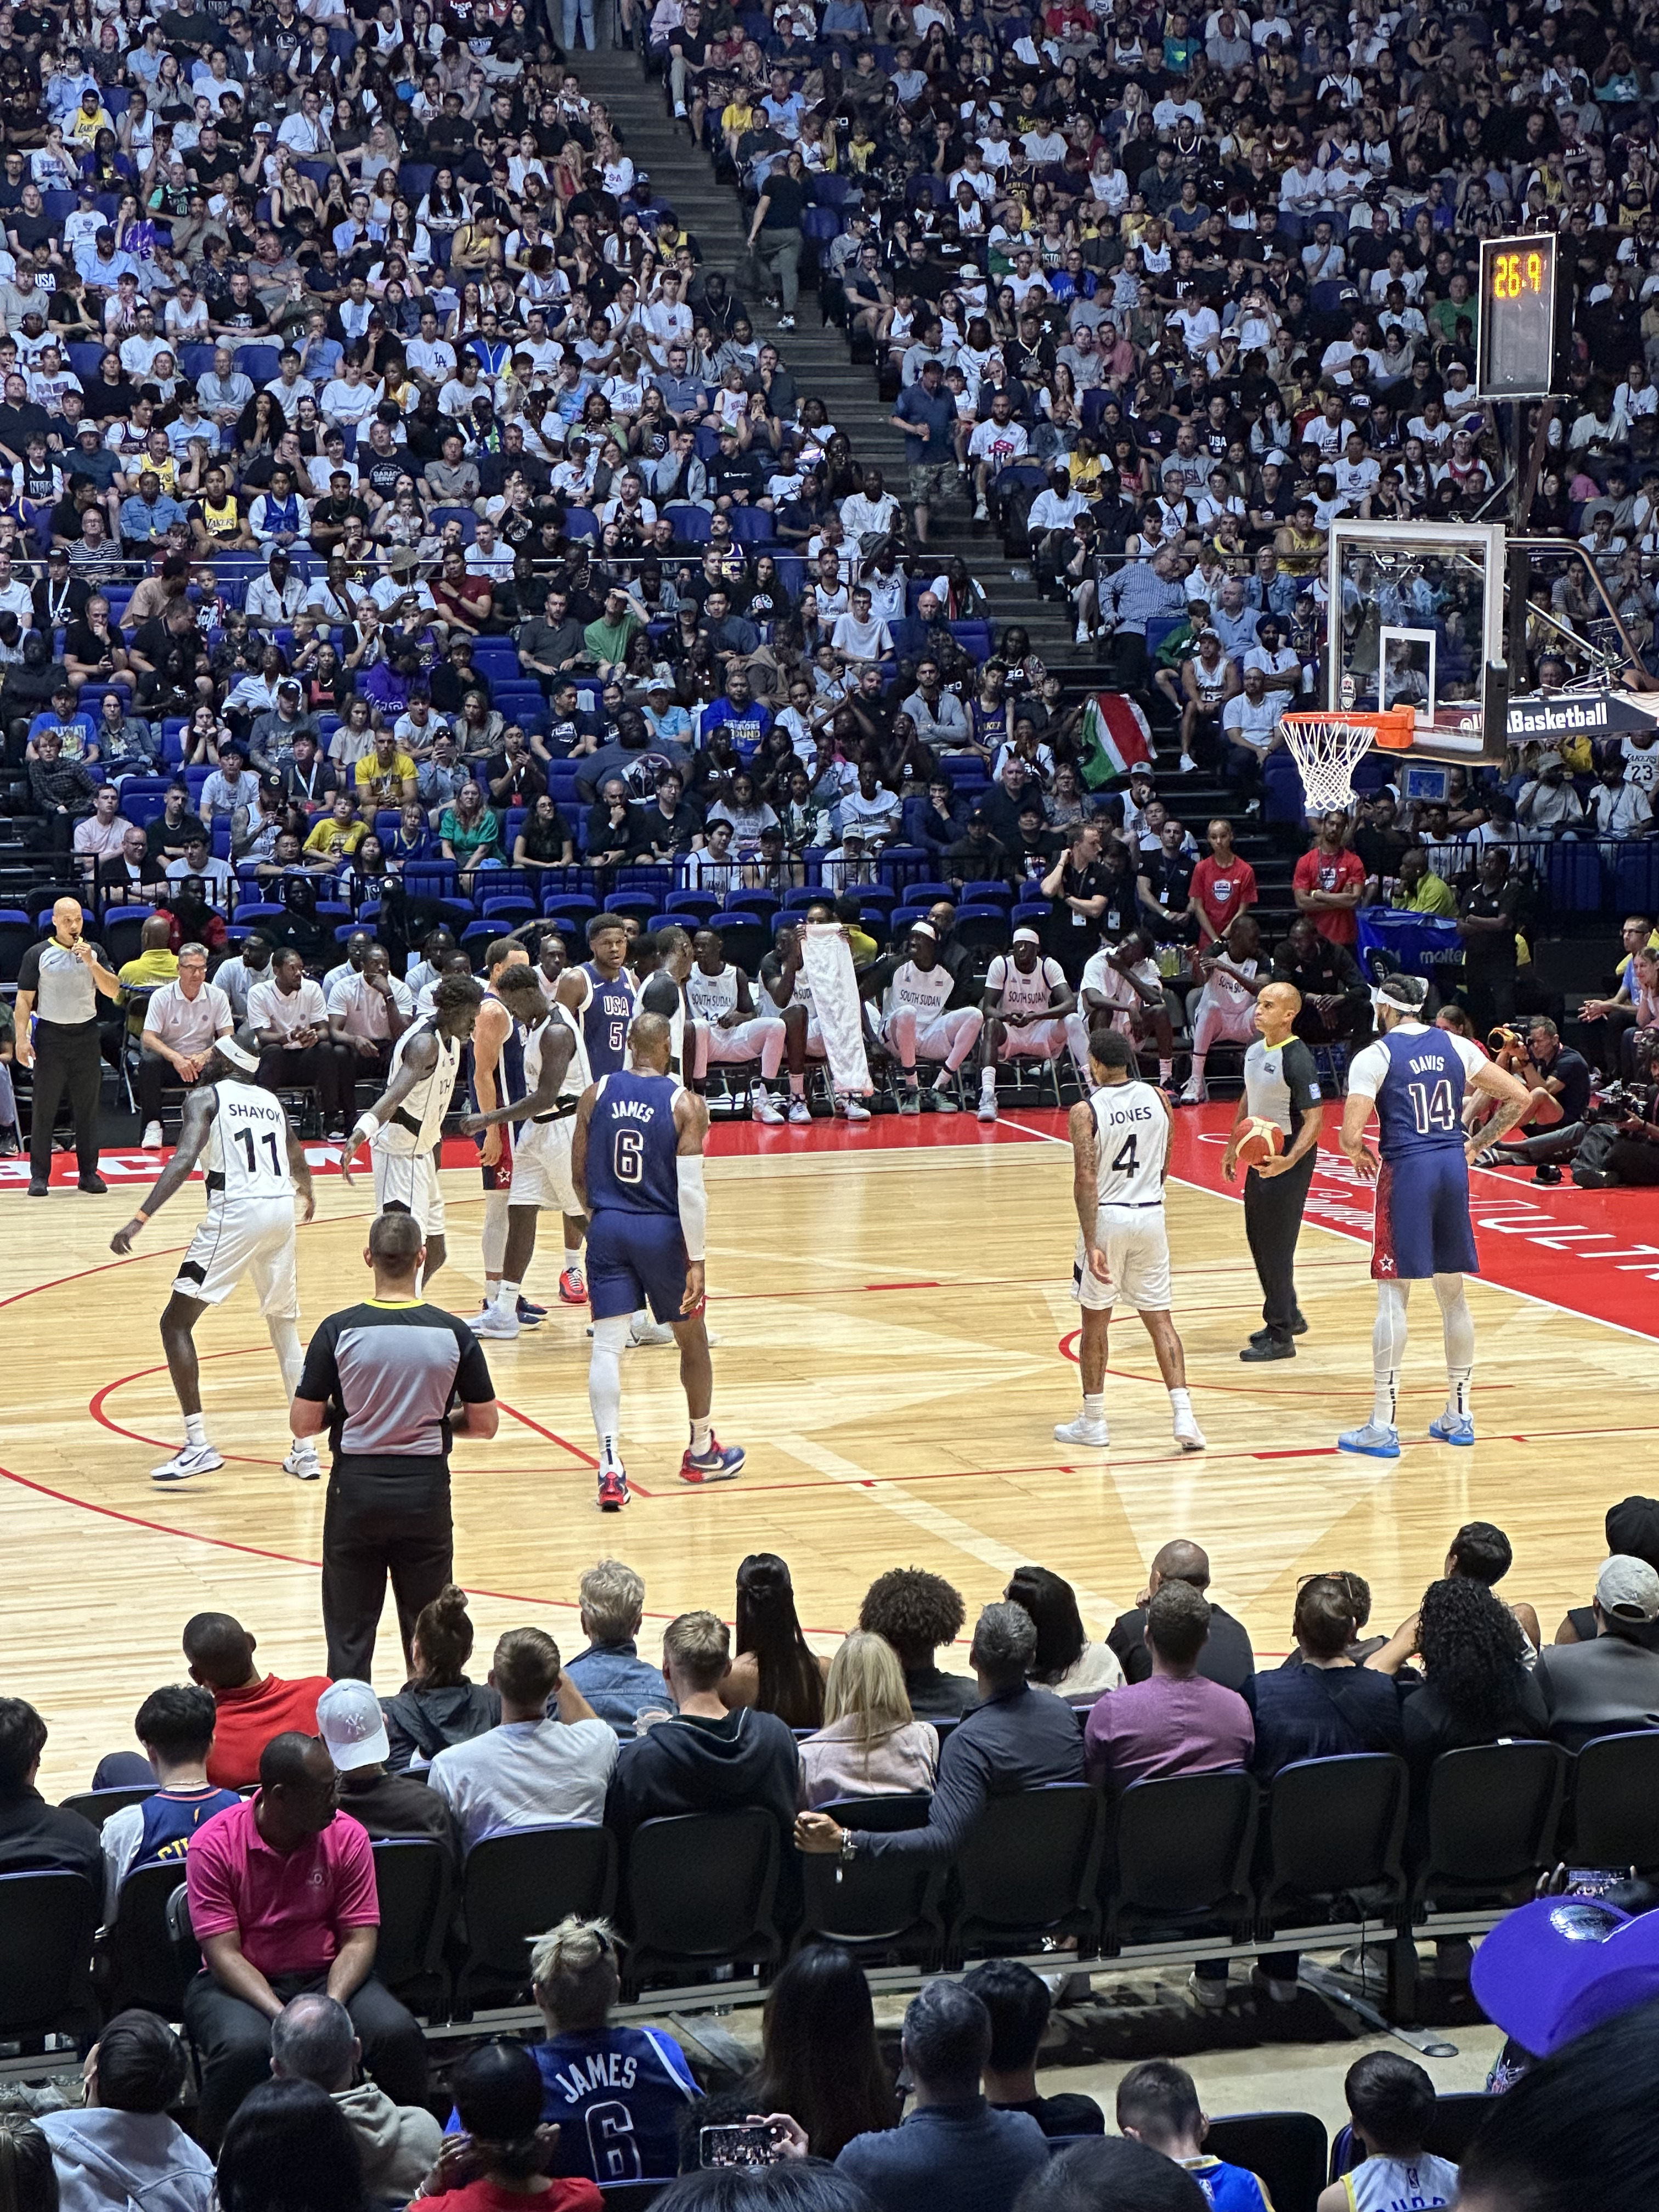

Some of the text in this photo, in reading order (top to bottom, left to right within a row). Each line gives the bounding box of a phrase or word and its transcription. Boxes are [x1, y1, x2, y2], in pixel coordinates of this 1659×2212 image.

[35, 273, 57, 288] USA
[1492, 254, 1540, 297] 26.9
[434, 352, 447, 369] LA
[620, 392, 639, 404] USA
[1209, 435, 1227, 448] USA
[30, 481, 53, 494] NETS
[207, 518, 235, 529] LAKERS
[1626, 754, 1657, 764] LAKERS
[1632, 765, 1654, 782] 23
[1421, 947, 1462, 964] molte
[603, 995, 630, 1017] USA
[692, 994, 711, 1005] SOUTH
[900, 989, 941, 1007] SOUTH SUDAN
[1008, 991, 1027, 1003] SOUTH
[608, 1022, 624, 1051] 5
[1409, 1054, 1445, 1075] DAVIS
[612, 1101, 654, 1123] JAMES
[1408, 1079, 1455, 1134] 14
[1110, 1107, 1152, 1126] JONES
[234, 1128, 282, 1177] 11
[614, 1129, 644, 1184] 6
[1111, 1134, 1140, 1178] 4
[555, 2053, 637, 2104] JAMES
[584, 2101, 641, 2182] 6
